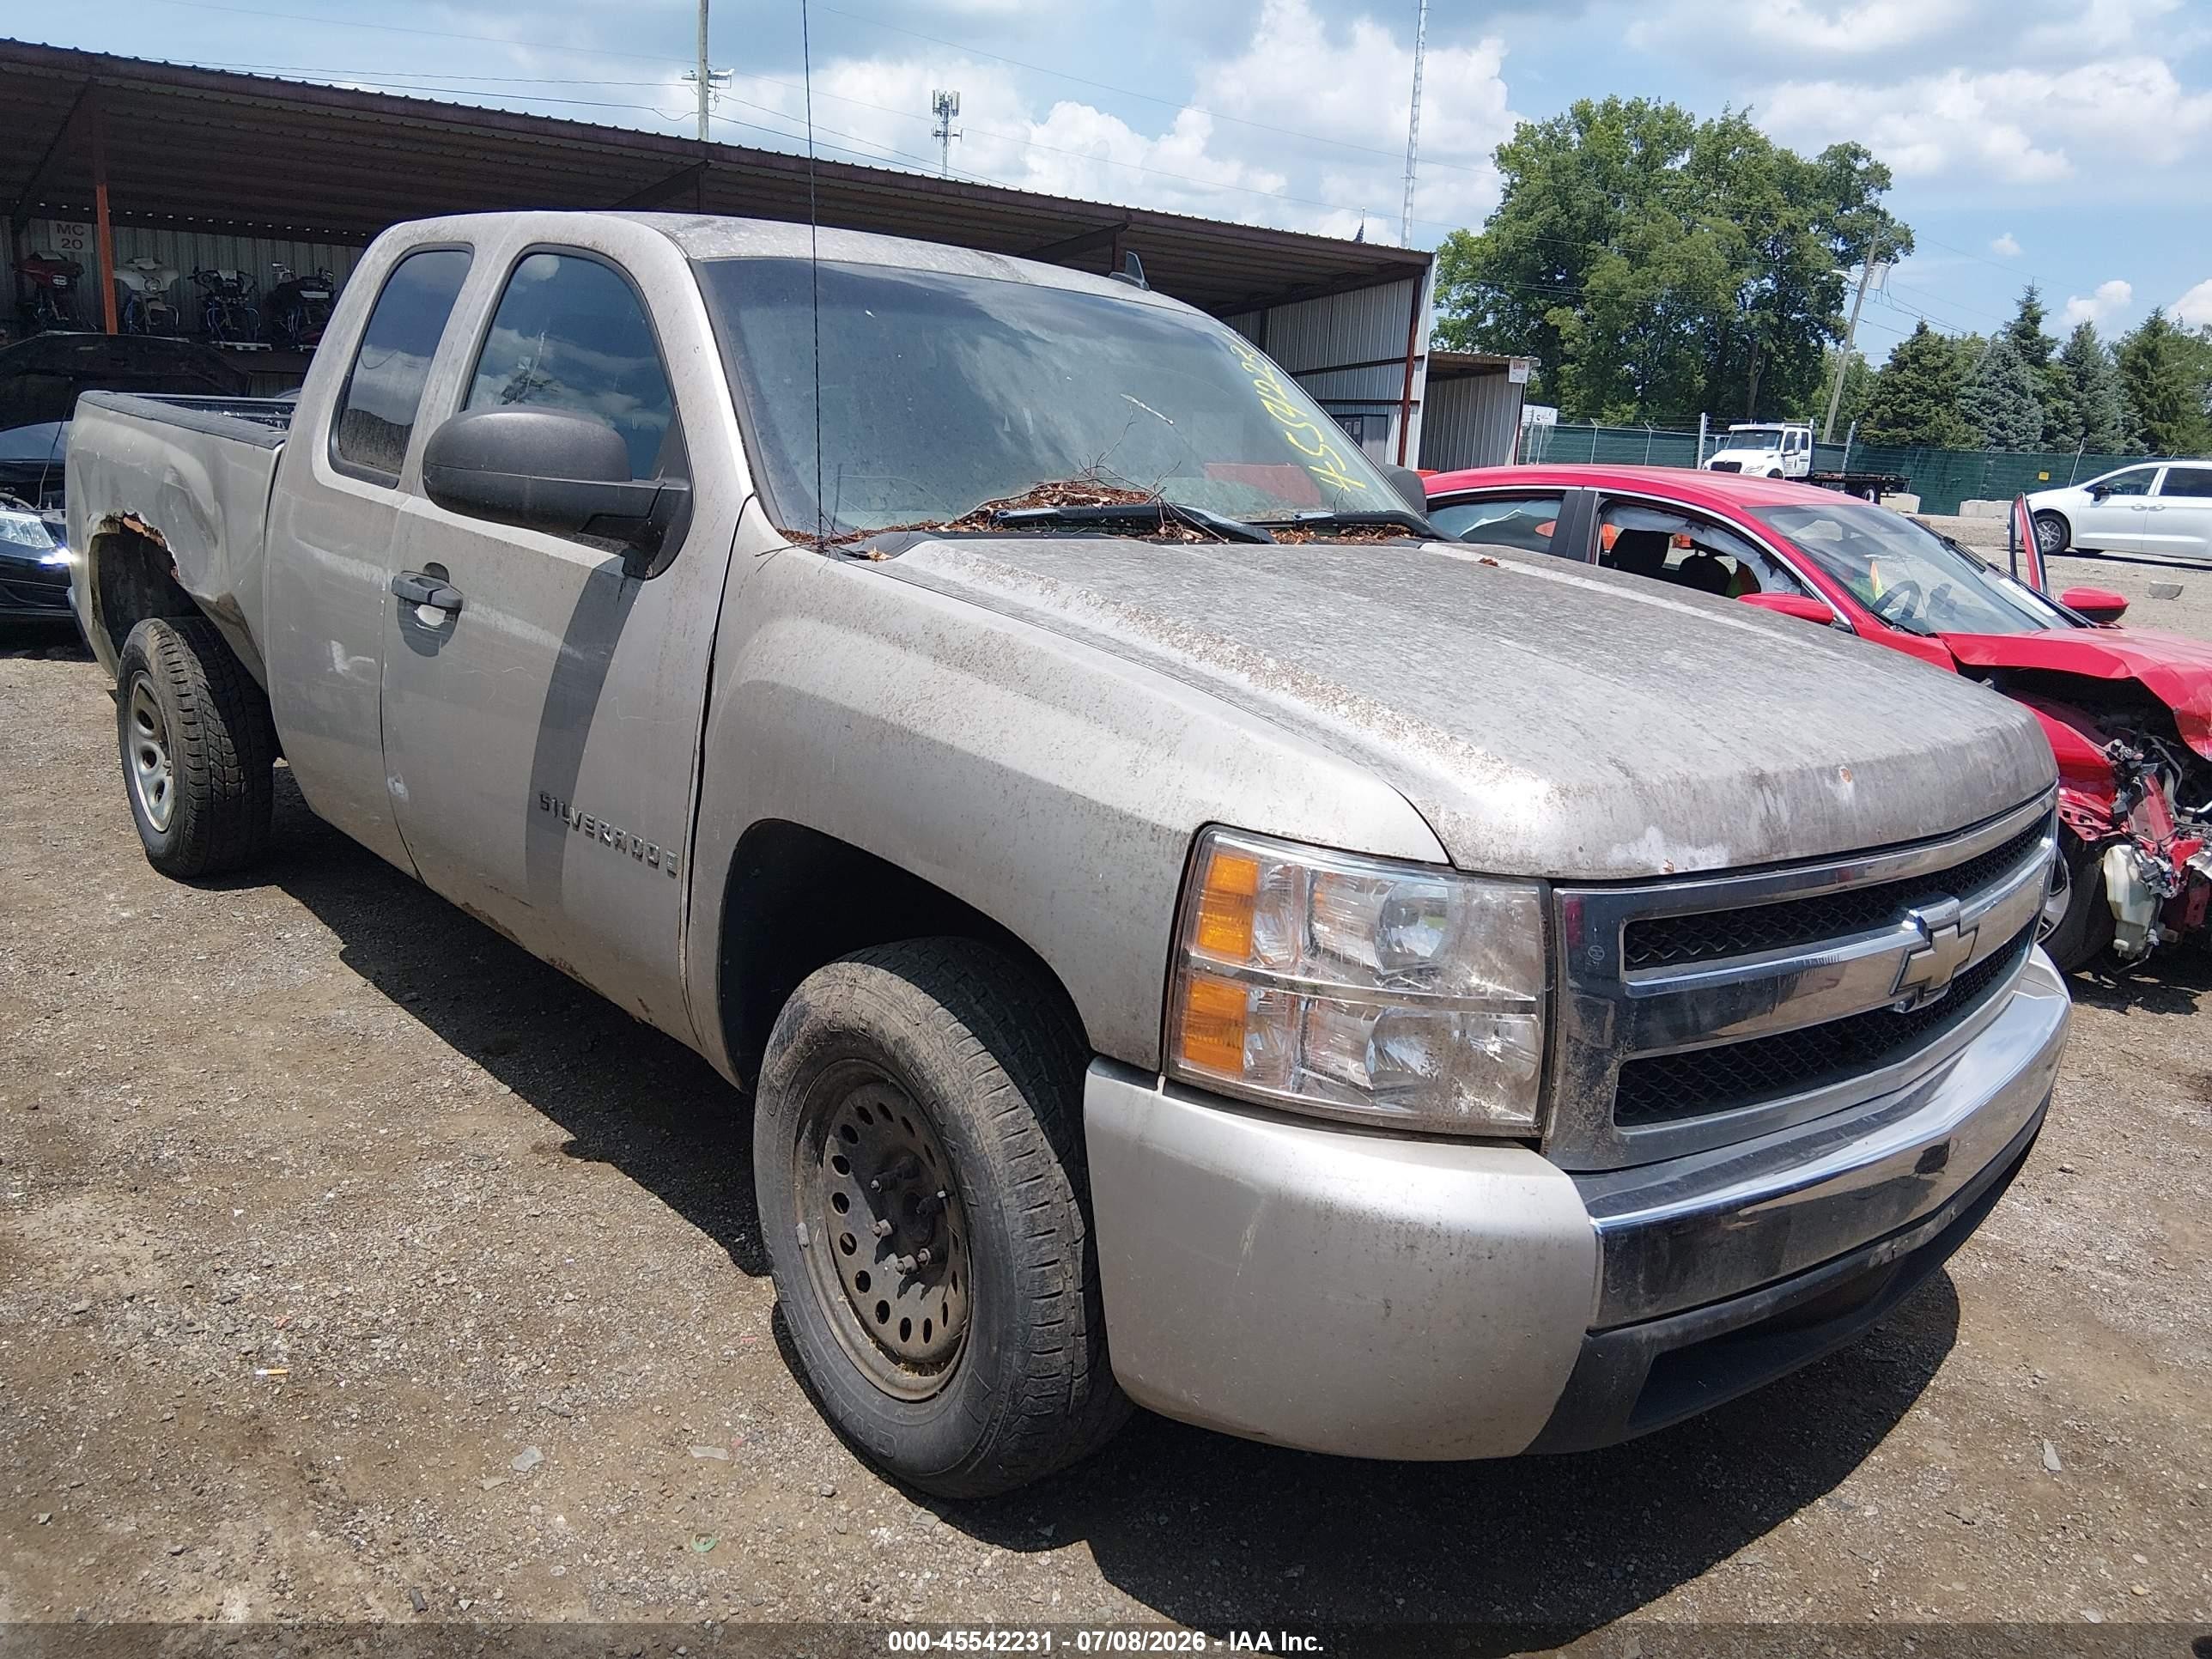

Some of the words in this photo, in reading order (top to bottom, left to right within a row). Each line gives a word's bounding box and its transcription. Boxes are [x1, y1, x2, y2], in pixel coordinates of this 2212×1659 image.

[57, 223, 85, 236] MC
[61, 238, 83, 250] 20
[540, 791, 660, 867] SILVERADO
